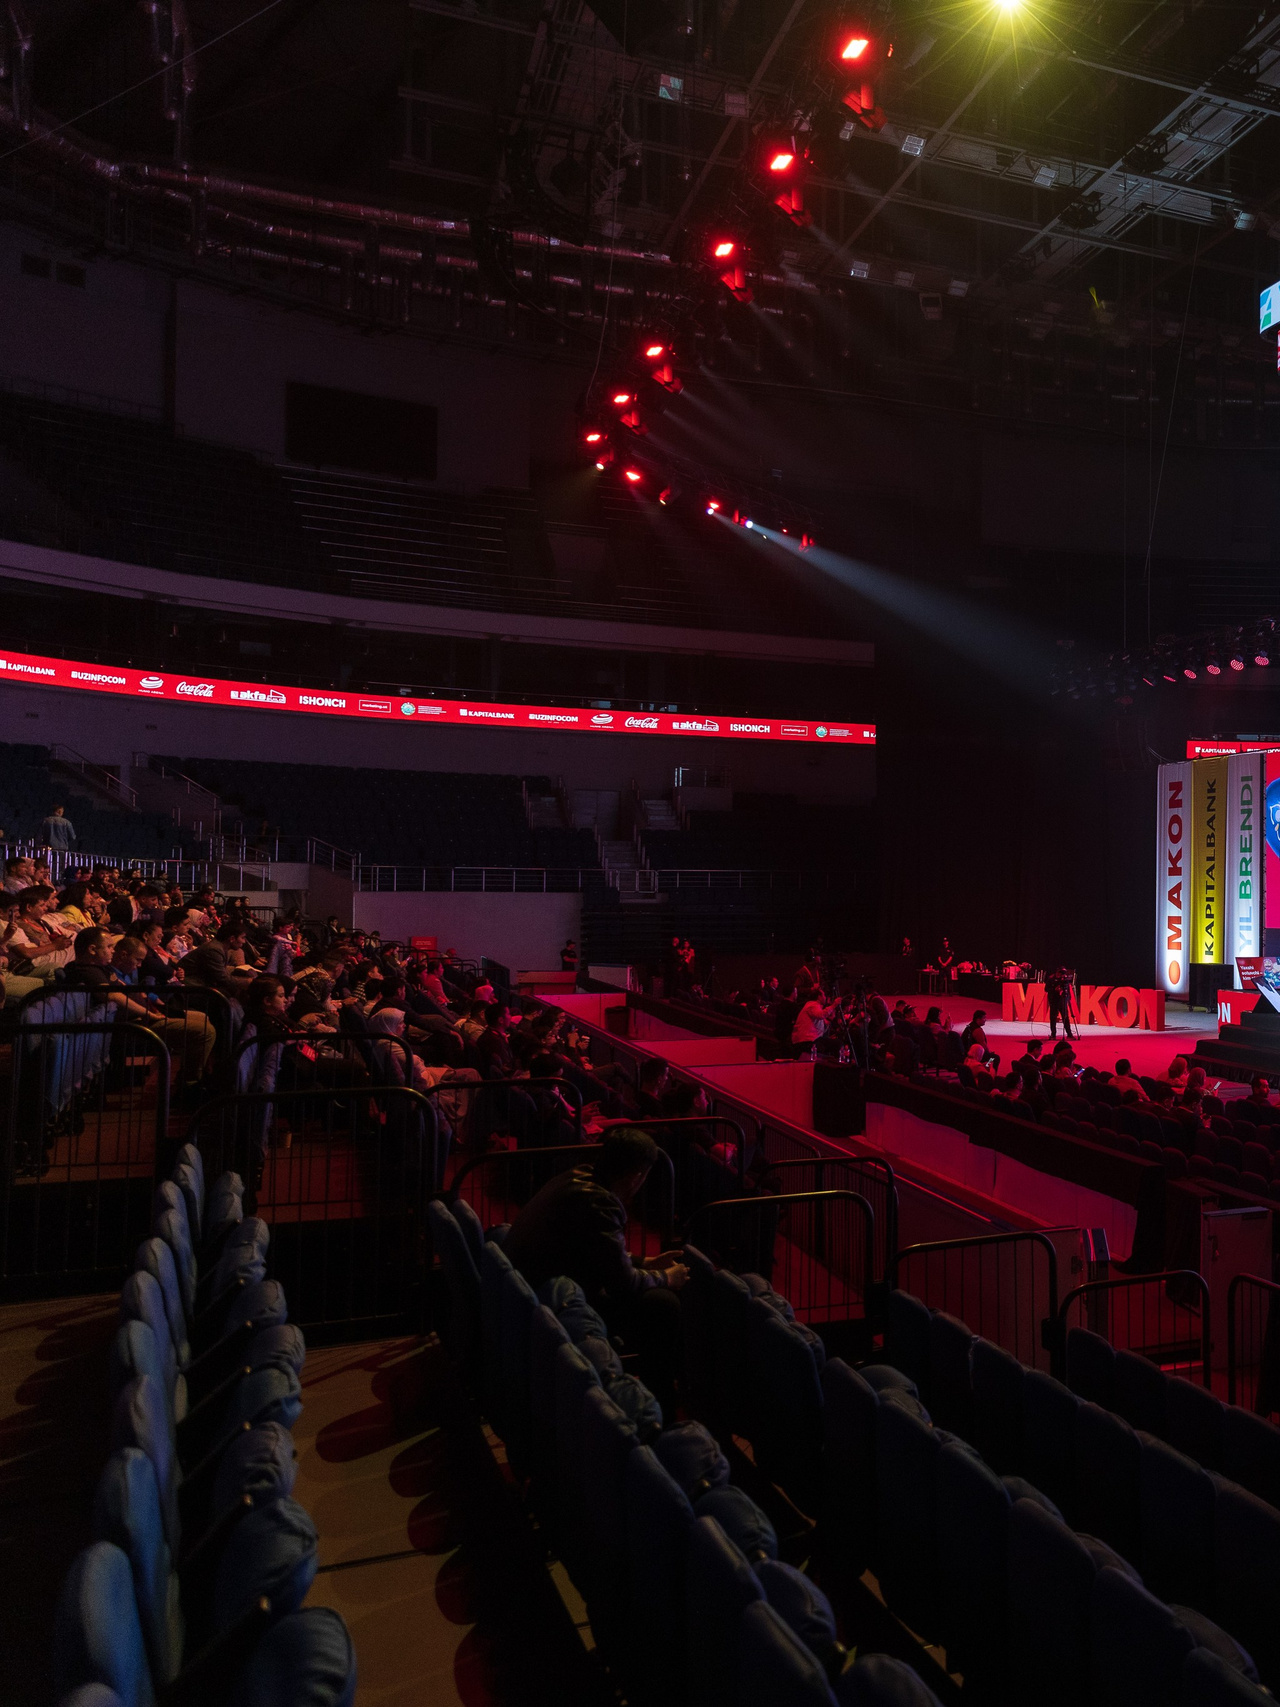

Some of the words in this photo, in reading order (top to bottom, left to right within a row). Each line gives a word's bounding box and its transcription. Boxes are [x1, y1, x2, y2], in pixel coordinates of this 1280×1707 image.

[7, 662, 55, 677] KAPITALBANK
[77, 672, 126, 685] UZINFOCOM
[240, 690, 266, 702] akfa
[299, 695, 346, 708] ISHONCH
[468, 711, 515, 719] KAPITALBANK
[535, 714, 579, 722] UZINFOCOM
[680, 721, 702, 730] akfa
[730, 724, 770, 733] ISHONCH
[1239, 775, 1253, 900] BRENDI
[1167, 780, 1183, 951] MAKON
[1204, 778, 1217, 956] KAPITALBANK
[1239, 906, 1252, 953] YIL
